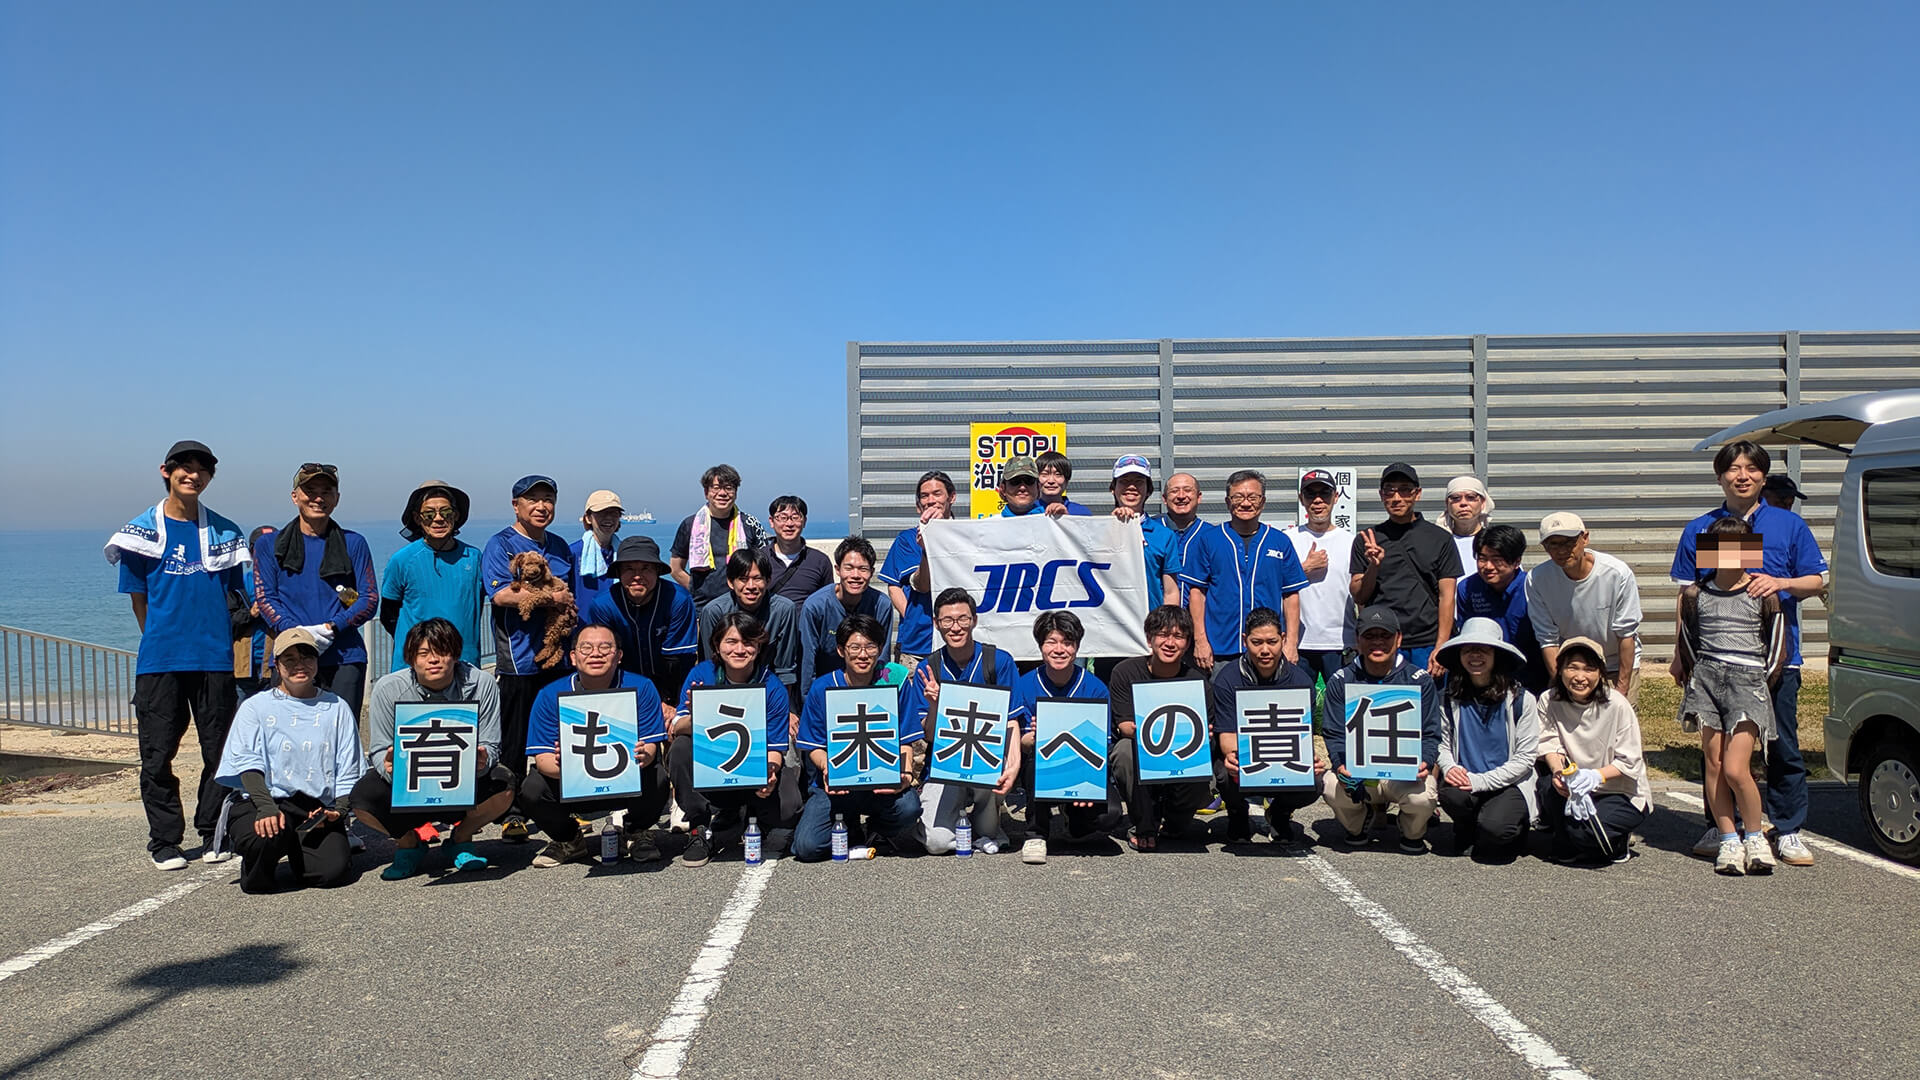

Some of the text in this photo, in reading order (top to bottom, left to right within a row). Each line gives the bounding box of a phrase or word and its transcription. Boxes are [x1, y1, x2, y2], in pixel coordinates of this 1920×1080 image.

[977, 435, 1058, 458] STOP!
[1334, 471, 1352, 532] 個人・家
[973, 559, 1112, 614] JRCS
[398, 718, 474, 791] 育
[570, 710, 630, 779] も
[705, 703, 751, 773] う
[830, 703, 898, 770] 未
[935, 701, 1002, 768] 来
[1039, 731, 1105, 770] へ
[1140, 703, 1205, 760] の
[1239, 703, 1312, 774] 責
[1345, 696, 1421, 766] 任
